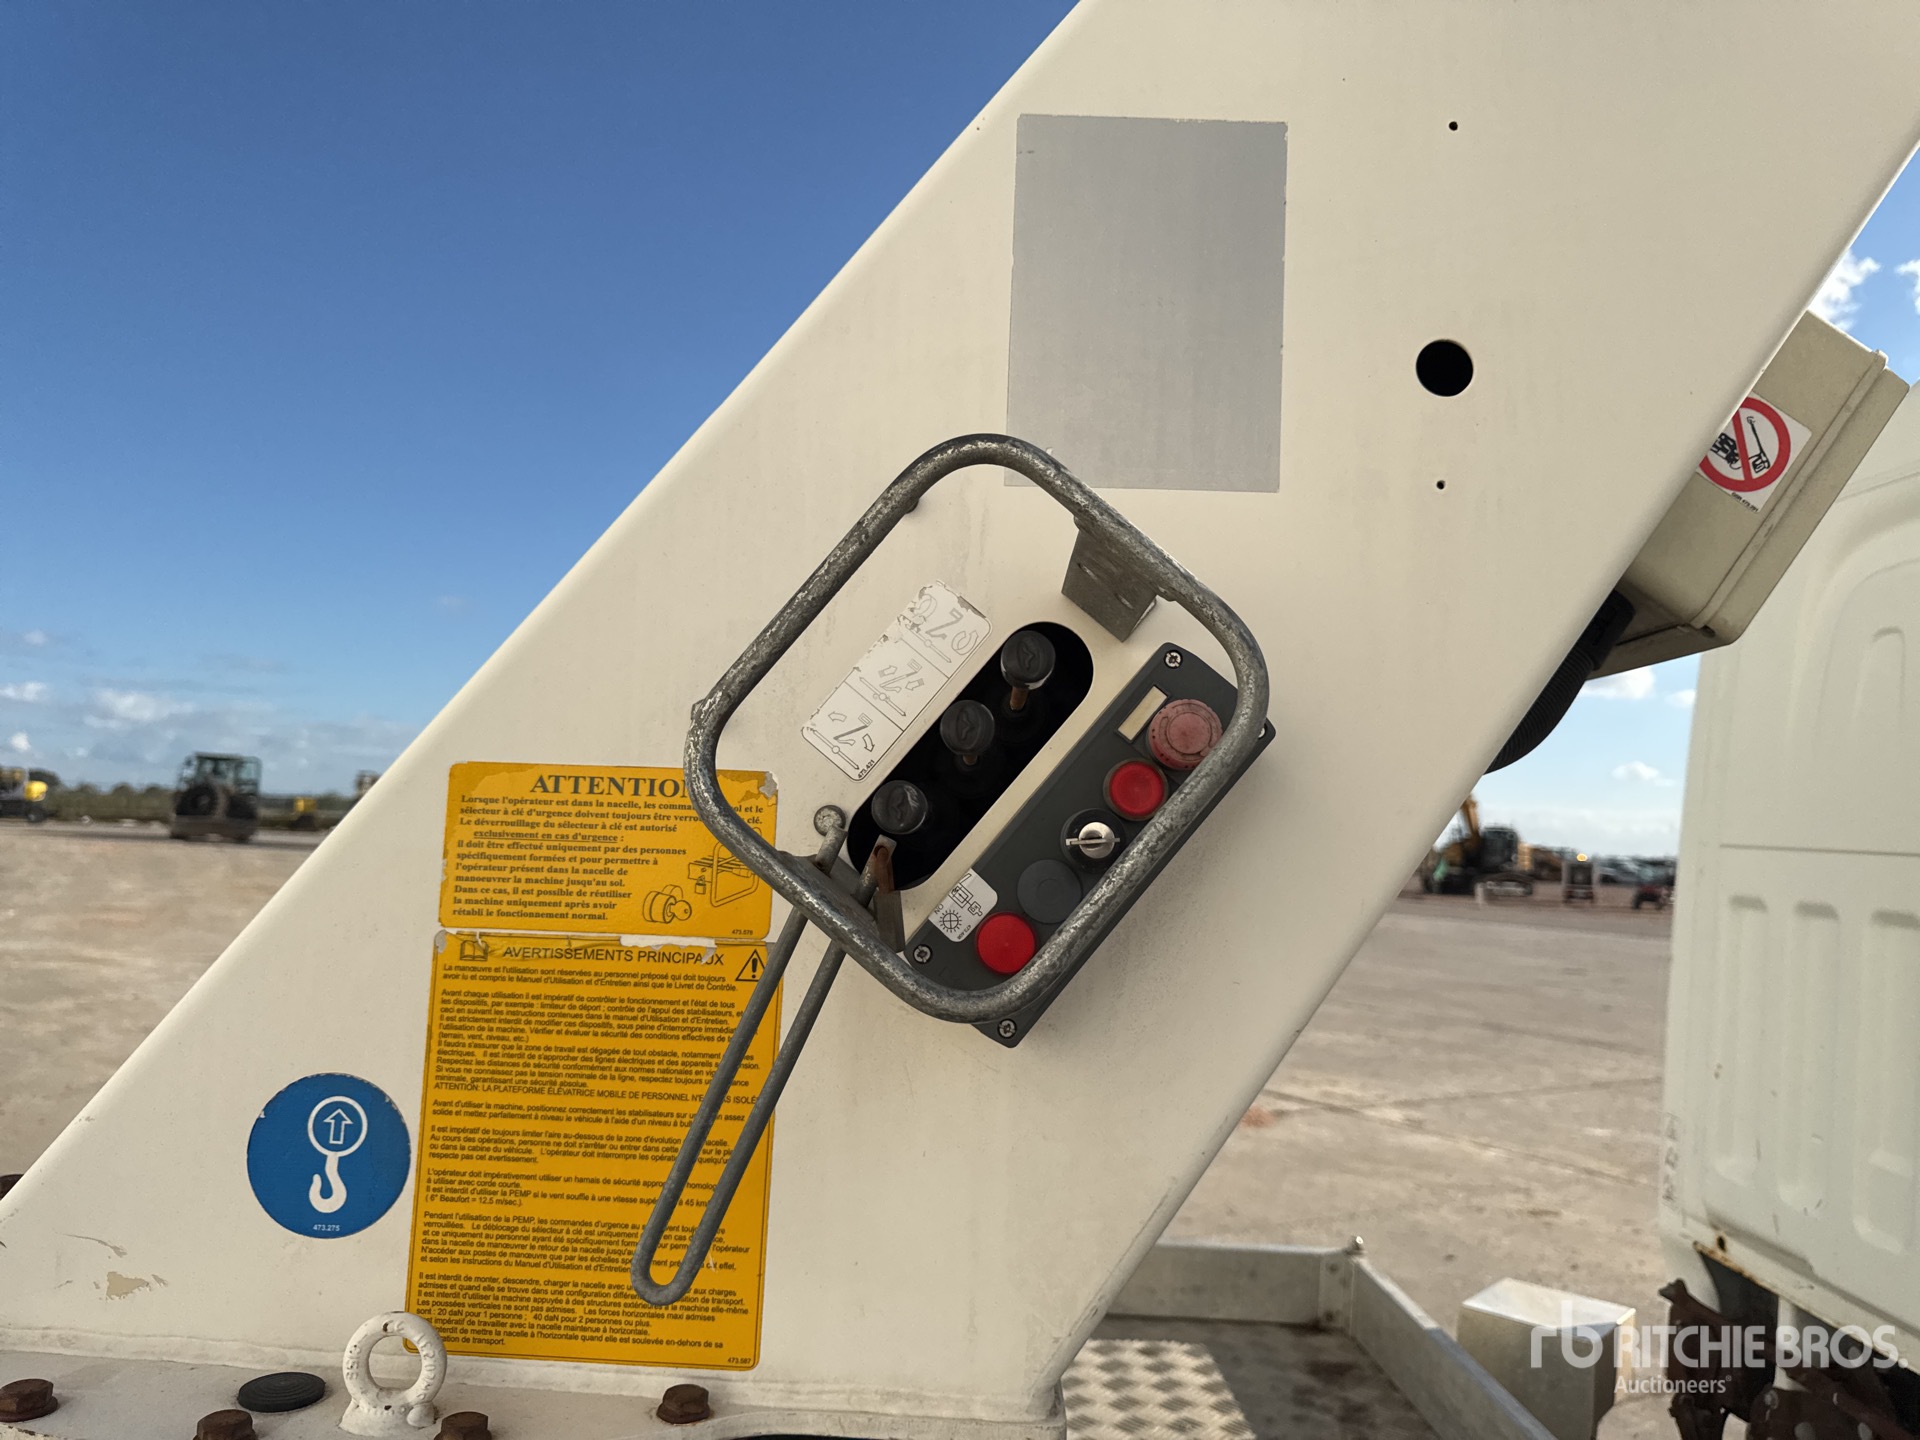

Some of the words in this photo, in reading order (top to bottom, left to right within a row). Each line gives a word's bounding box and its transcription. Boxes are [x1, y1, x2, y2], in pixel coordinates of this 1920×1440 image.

[461, 795, 499, 805] Lorsque
[502, 796, 553, 807] l'opérateur
[606, 800, 641, 809] nacelle,
[459, 806, 501, 814] sélecteur
[526, 808, 572, 819] d'urgence
[574, 810, 609, 818] doivent
[611, 811, 651, 821] toujours
[473, 818, 540, 829] déverrouillage
[557, 820, 599, 829] sélecteur
[639, 823, 677, 831] autorisé
[473, 829, 538, 838] exclusivement
[571, 832, 618, 842] d'urgence
[506, 841, 543, 849] effectué
[545, 843, 601, 853] uniquement
[639, 847, 686, 856] personnes
[456, 851, 526, 862] spécifiquement
[528, 853, 566, 861] formées
[579, 857, 602, 865] pour
[604, 856, 650, 866] permettre
[455, 862, 508, 873] l'opérateur
[509, 864, 544, 874] présent
[524, 876, 564, 884] machine
[566, 877, 607, 888] jusqu'au
[536, 888, 573, 898] possible
[506, 898, 562, 908] uniquement
[564, 900, 590, 910] après
[496, 909, 569, 918] fonctionnement
[503, 946, 633, 961] AVERTISSEMENTS
